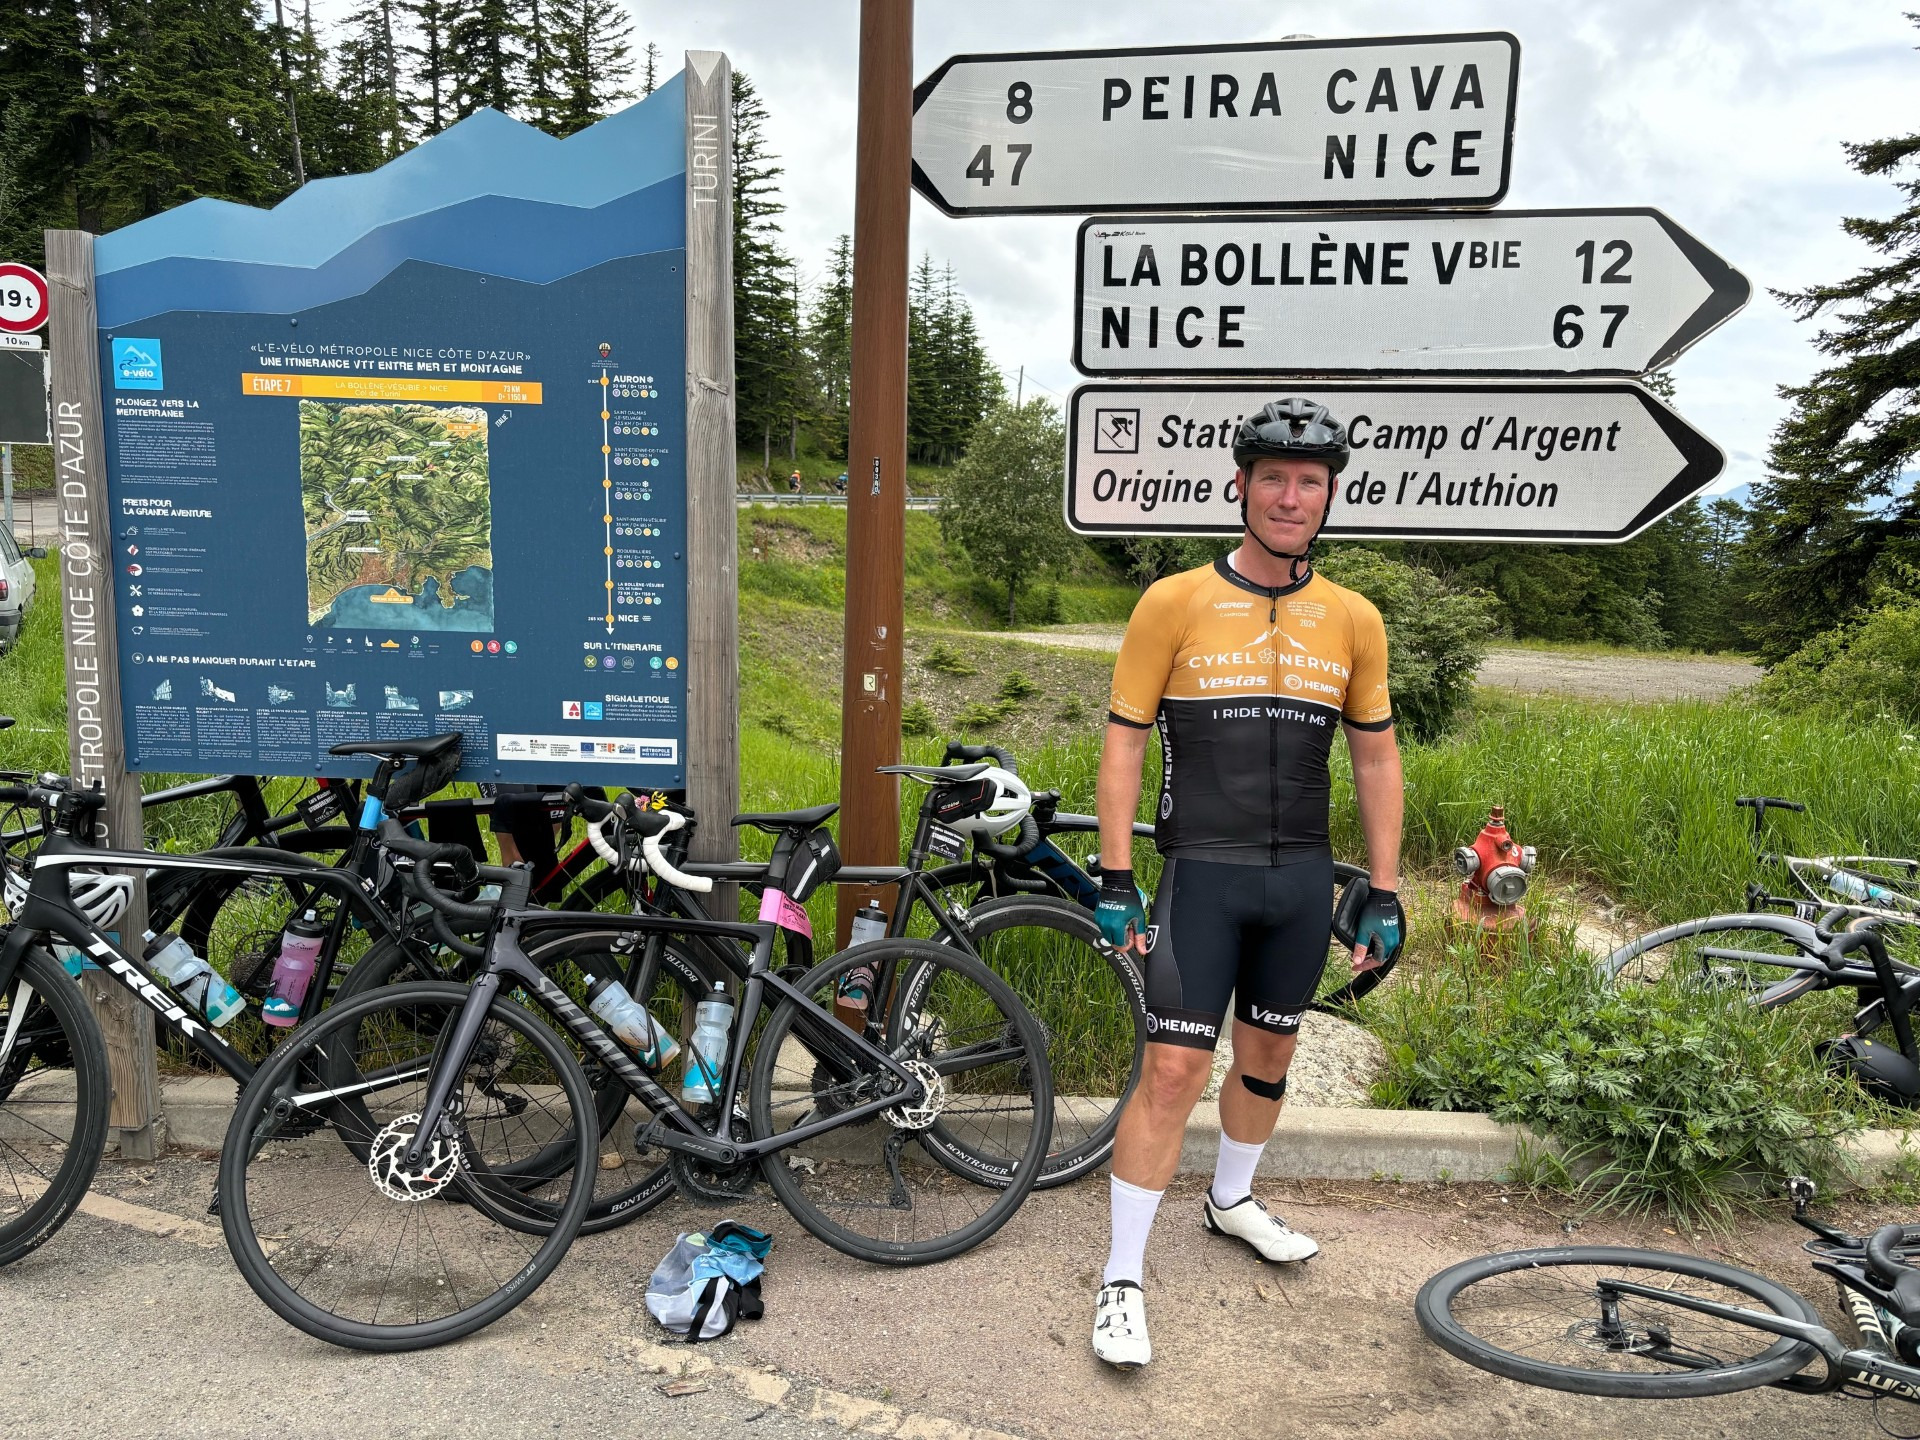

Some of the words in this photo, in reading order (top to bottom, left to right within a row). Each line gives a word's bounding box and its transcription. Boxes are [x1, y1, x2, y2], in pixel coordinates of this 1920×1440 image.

[1007, 81, 1033, 124] 8
[1102, 71, 1283, 122] PEIRA
[1326, 63, 1485, 114] CAVA
[693, 115, 718, 209] TURINI
[965, 143, 1033, 187] 47
[1323, 130, 1482, 180] NICE
[1102, 245, 1161, 287] LA
[1180, 233, 1410, 286] BOLLÈNE
[1575, 239, 1633, 284] 12
[1101, 305, 1247, 349] NICE
[1553, 304, 1630, 348] 67
[5, 337, 17, 345] 10
[320, 344, 398, 357] MÉTROPOLE
[403, 348, 433, 358] NICE
[438, 347, 472, 359] CÔTE
[123, 367, 154, 377] e-vélo
[260, 357, 282, 366] UNE
[285, 357, 350, 368] ITINERANCE
[353, 360, 375, 369] VTT
[378, 361, 414, 371] ENTRE
[416, 362, 440, 372] MER
[443, 363, 457, 372] ET
[460, 363, 522, 374] MONTAGNE
[253, 376, 283, 392] ÉTAPE
[284, 380, 291, 392] 7
[613, 375, 646, 384] AURON
[115, 398, 158, 407] PLONGEZ
[160, 399, 184, 408] VERS
[186, 400, 199, 408] LA
[116, 408, 184, 417] MEDITERRANEE
[1157, 413, 1245, 449] Stati
[1347, 414, 1449, 458] Camp
[1460, 416, 1622, 462] d'Argent
[58, 401, 87, 498] D'AZUR
[1092, 468, 1213, 510] Origine
[1346, 472, 1386, 505] de
[1396, 470, 1560, 509] l'Authion
[122, 498, 148, 507] PRETS
[149, 499, 172, 507] POUR
[123, 507, 135, 515] LA
[135, 507, 169, 516] GRANDE
[170, 509, 212, 518] AVENTURE
[61, 509, 92, 577] CÔTE
[69, 587, 97, 646] NICE
[618, 614, 640, 622] NICE
[1299, 619, 1317, 629] 2024
[583, 642, 602, 650] SUR
[605, 643, 662, 652] L'ITINERAIRE
[147, 655, 154, 663] A
[170, 656, 190, 664] PAS
[192, 657, 237, 666] MANQUER
[239, 658, 276, 667] DURANT
[279, 658, 317, 668] L'ETAPE
[1188, 651, 1256, 670] CYKEL
[1279, 652, 1351, 681] NERVEN
[1198, 674, 1269, 690] Vestas
[1304, 679, 1342, 698] HEMPEL
[605, 694, 670, 703] SIGNALETIQUE
[1212, 709, 1218, 720] I
[1222, 707, 1261, 720] RIDE
[1265, 707, 1306, 723] WITH
[1309, 714, 1327, 728] MS
[1157, 709, 1173, 791] HEMPEL
[664, 951, 699, 983] BONTRA
[87, 932, 206, 1038] TREK
[1159, 1019, 1217, 1038] HEMPEL
[946, 1142, 1009, 1175] BONTRAGER
[610, 1172, 673, 1214] BONTRAGE
